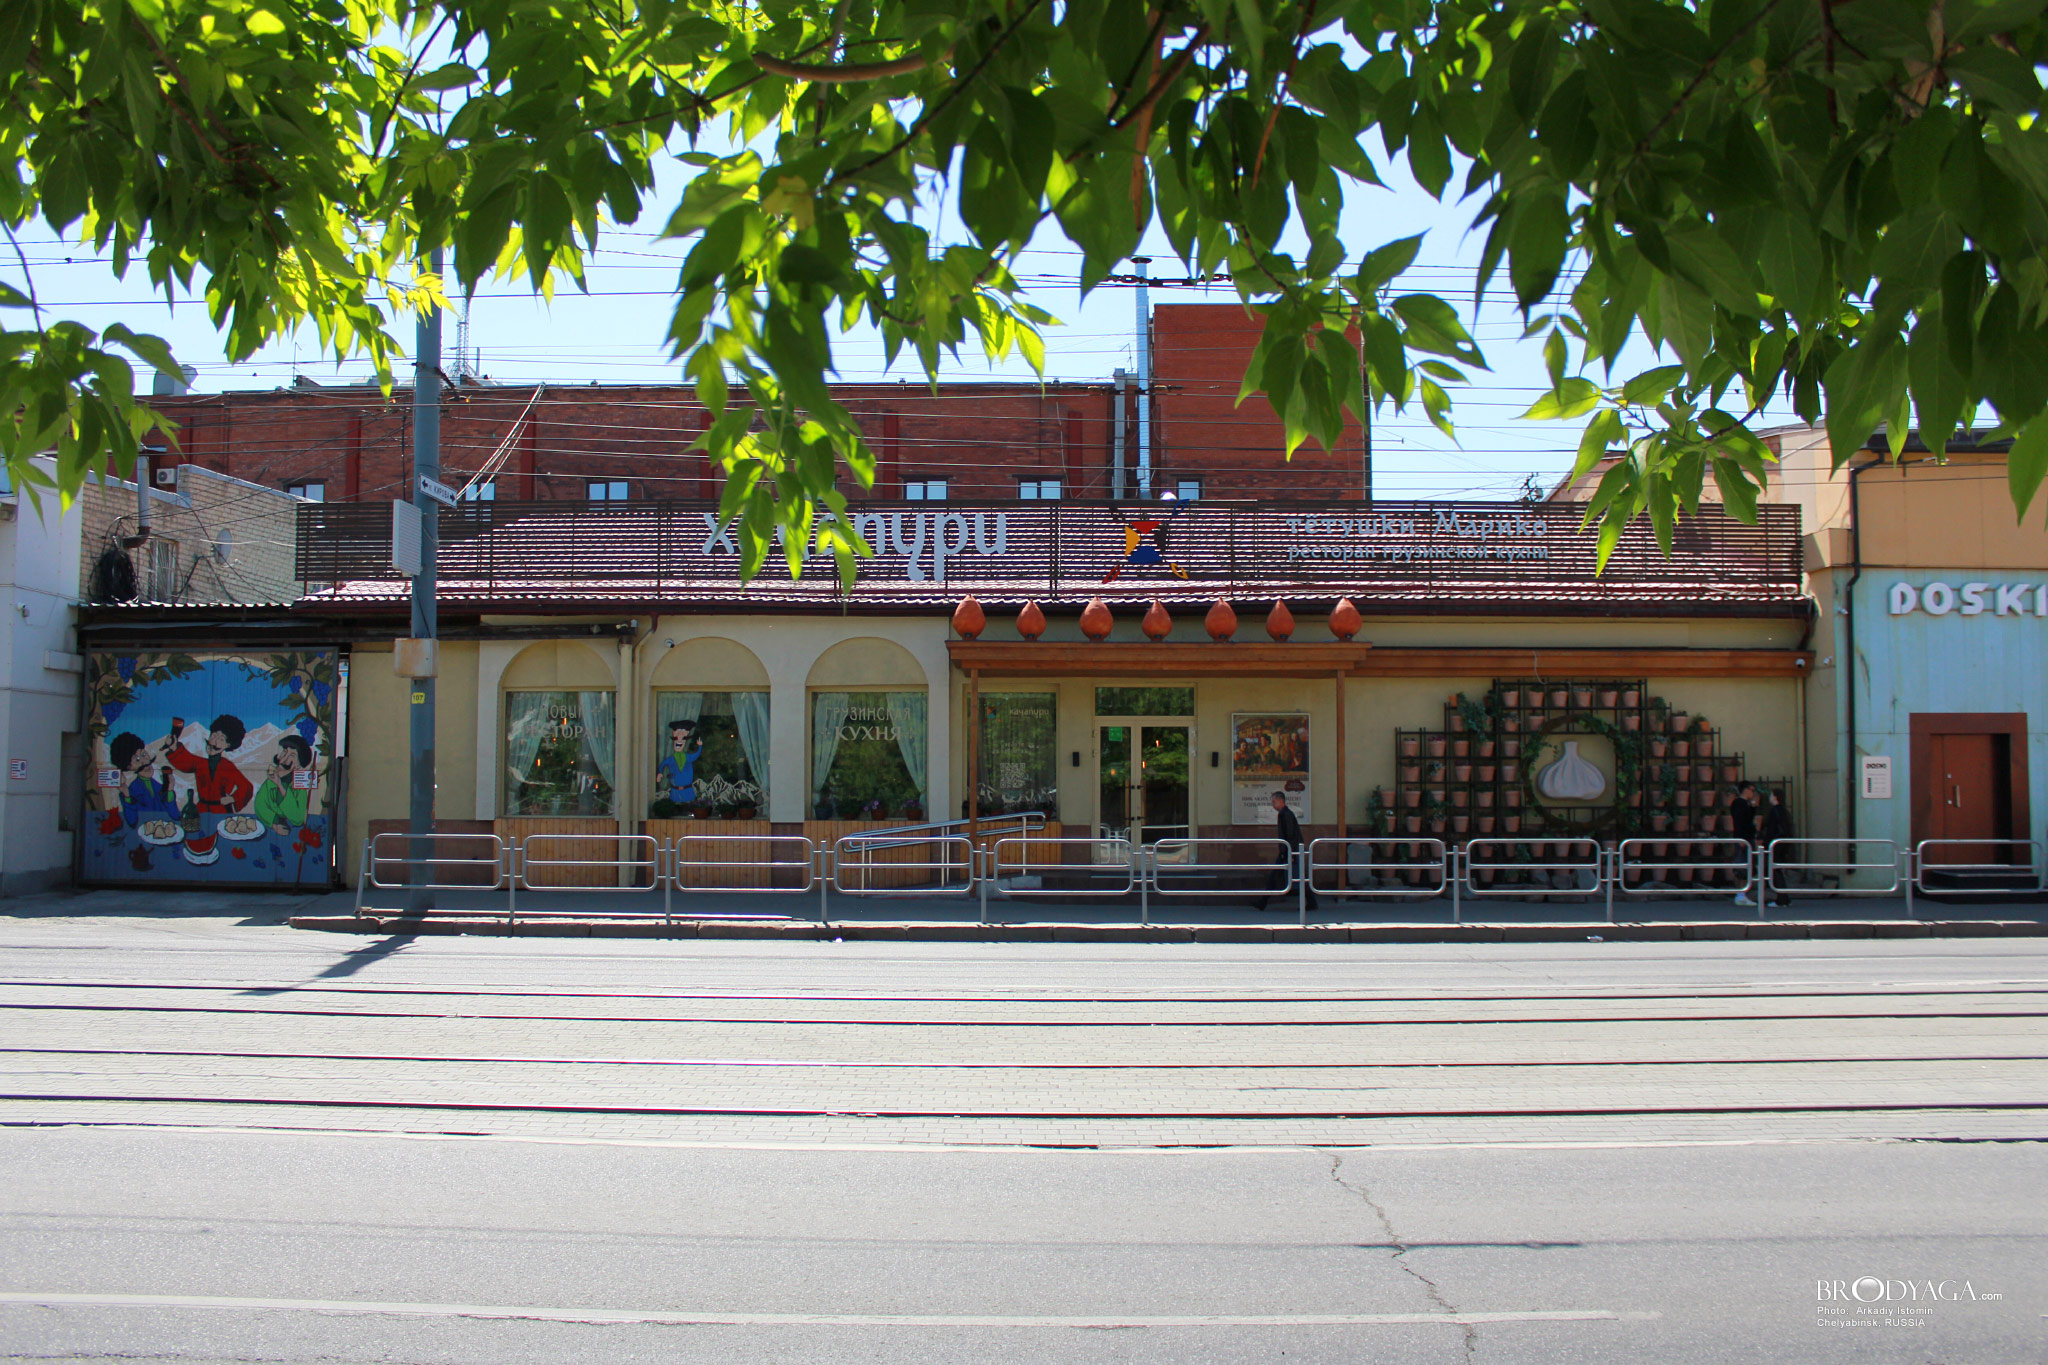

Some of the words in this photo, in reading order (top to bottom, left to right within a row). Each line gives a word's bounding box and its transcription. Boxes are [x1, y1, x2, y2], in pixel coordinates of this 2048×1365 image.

[1285, 513, 1416, 539] тётушки
[1433, 511, 1548, 541] Марико
[701, 513, 1007, 582] хпури
[1287, 544, 1376, 563] ресторан
[1382, 543, 1490, 563] грузинской
[1495, 544, 1550, 563] кухни
[1889, 582, 2047, 616] DOSKI
[834, 726, 902, 741] КУХНЯ
